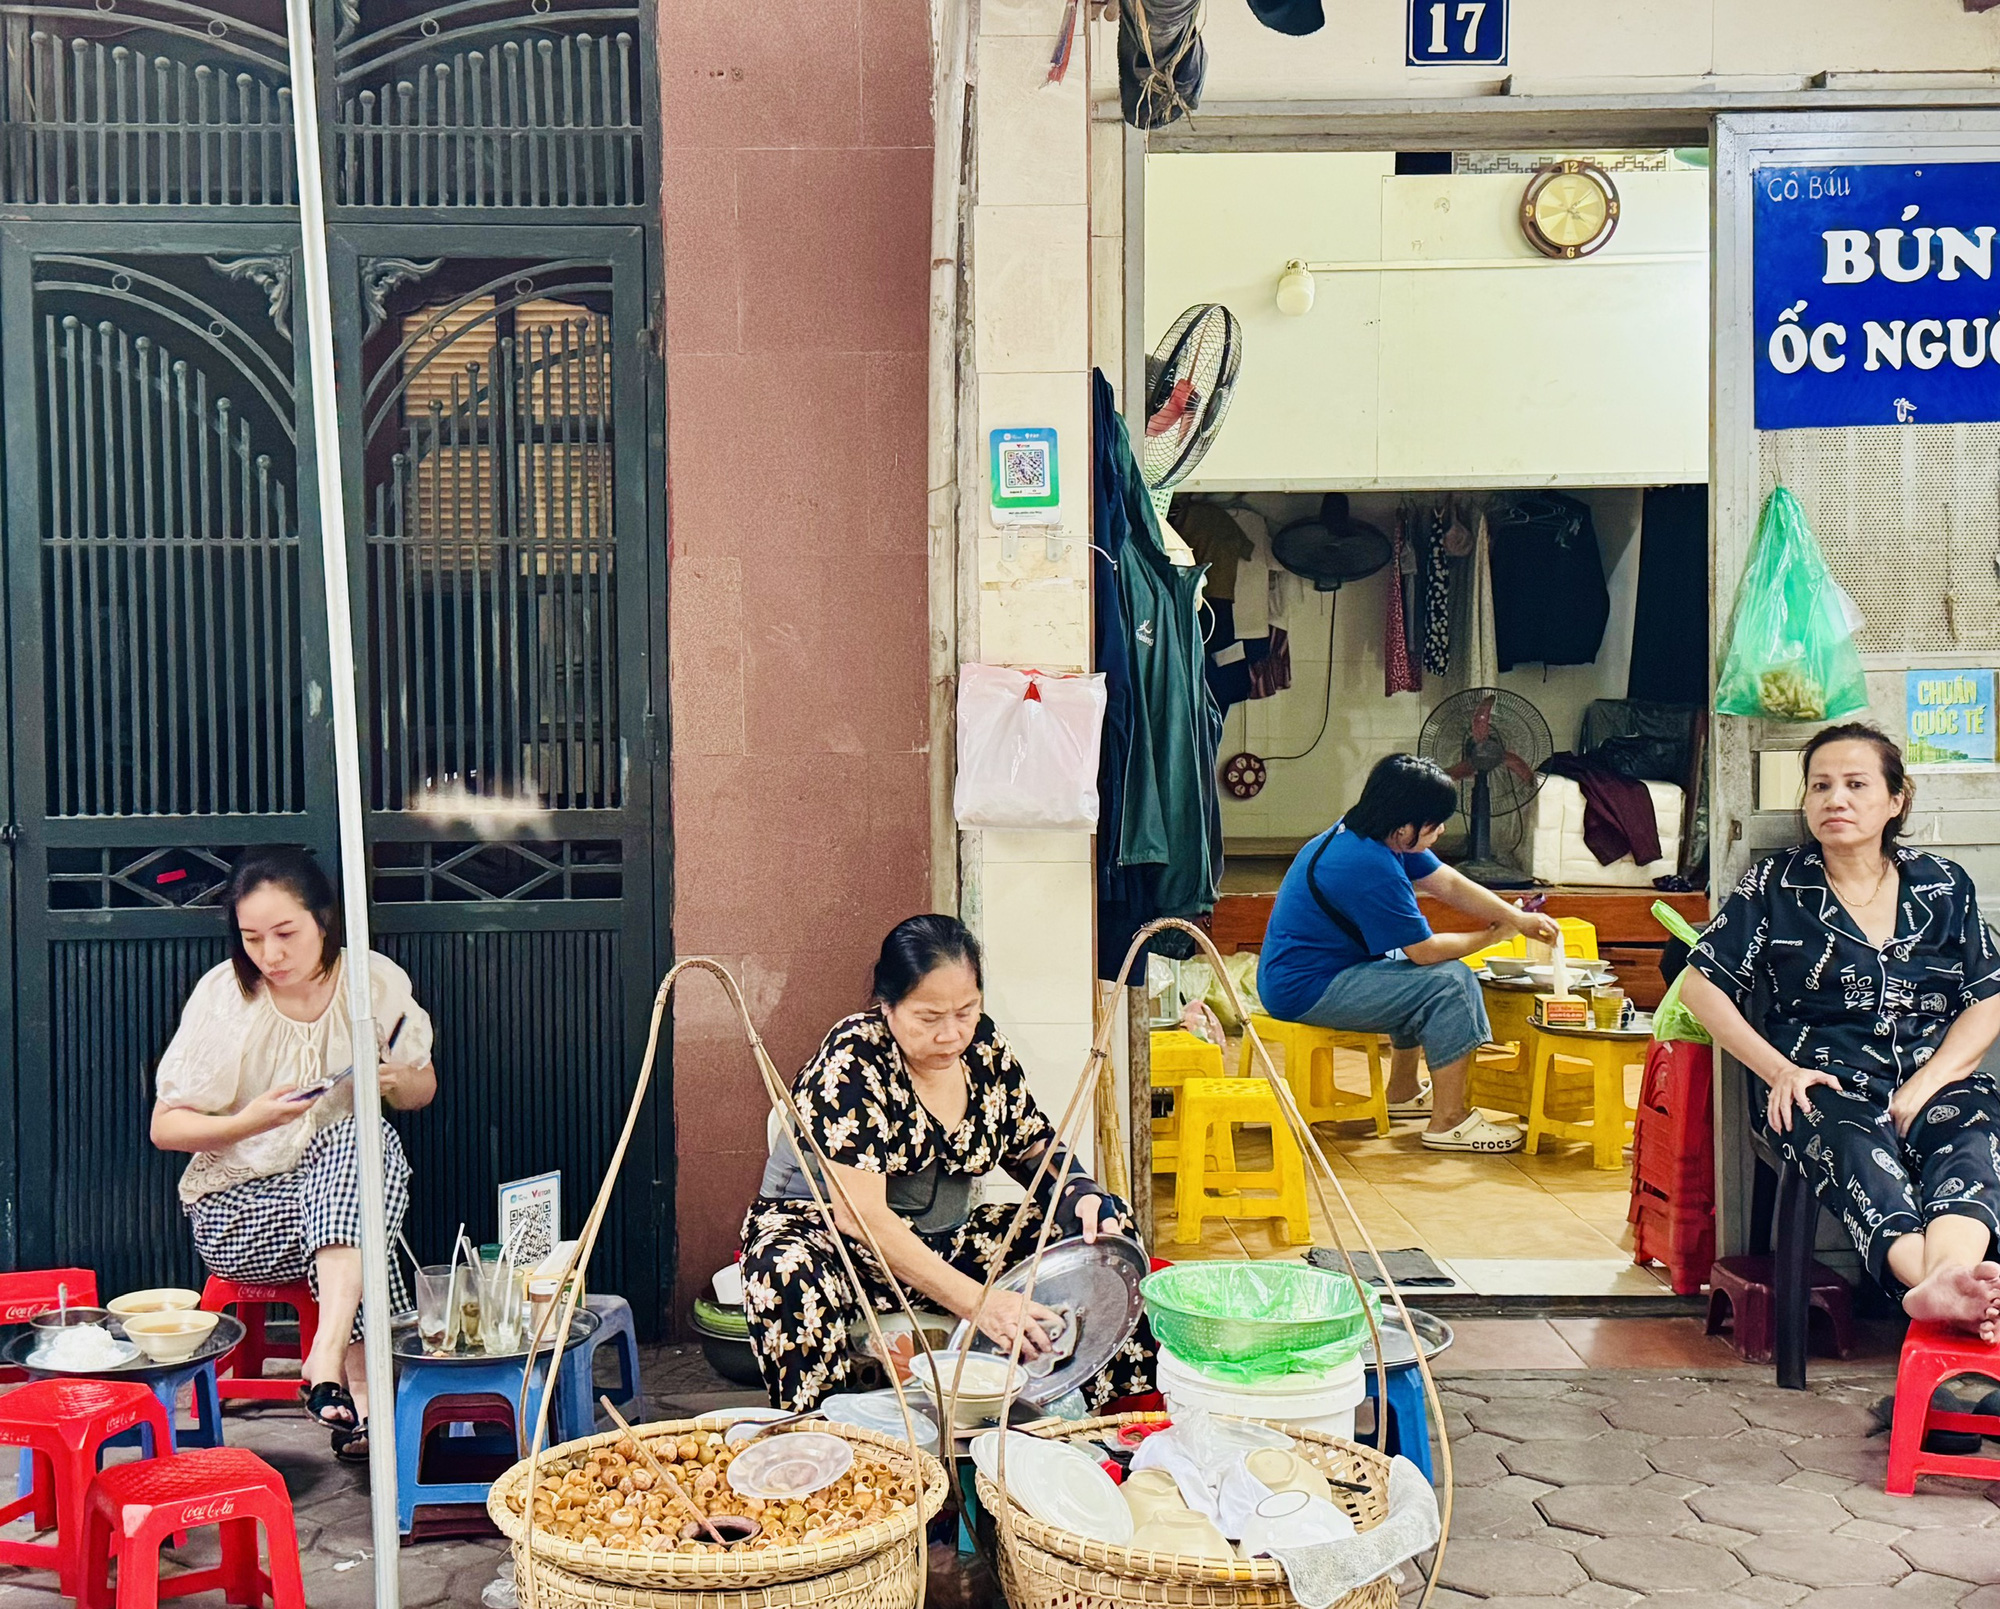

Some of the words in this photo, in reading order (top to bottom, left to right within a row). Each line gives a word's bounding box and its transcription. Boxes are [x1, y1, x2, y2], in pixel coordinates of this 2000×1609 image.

[1427, 3, 1486, 54] 17
[1564, 161, 1580, 174] 12
[1525, 204, 1534, 217] 9
[1609, 202, 1618, 215] 3
[1821, 204, 1997, 284] BÚN
[1566, 246, 1575, 258] 6
[1768, 299, 1847, 374] ỐC
[1805, 931, 1836, 990] Gianni
[1472, 1139, 1512, 1150] crocs
